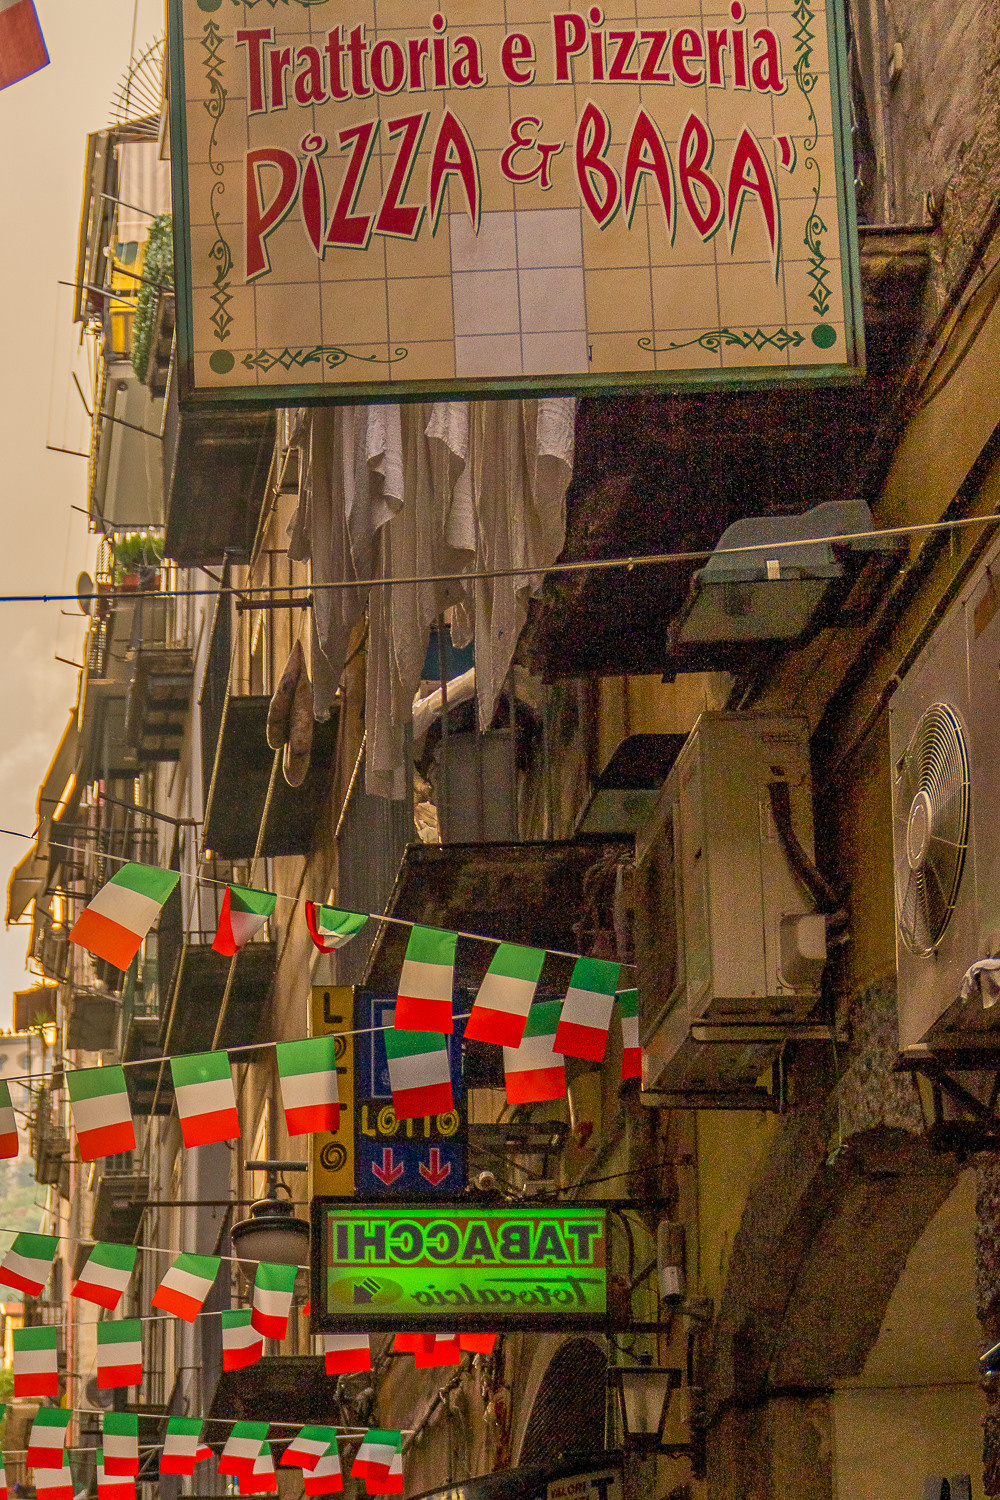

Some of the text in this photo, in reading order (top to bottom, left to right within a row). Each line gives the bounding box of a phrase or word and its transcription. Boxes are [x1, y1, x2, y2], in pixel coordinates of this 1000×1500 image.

[237, 1, 787, 115] Trattoria e Pizzeria
[500, 115, 562, 190] &
